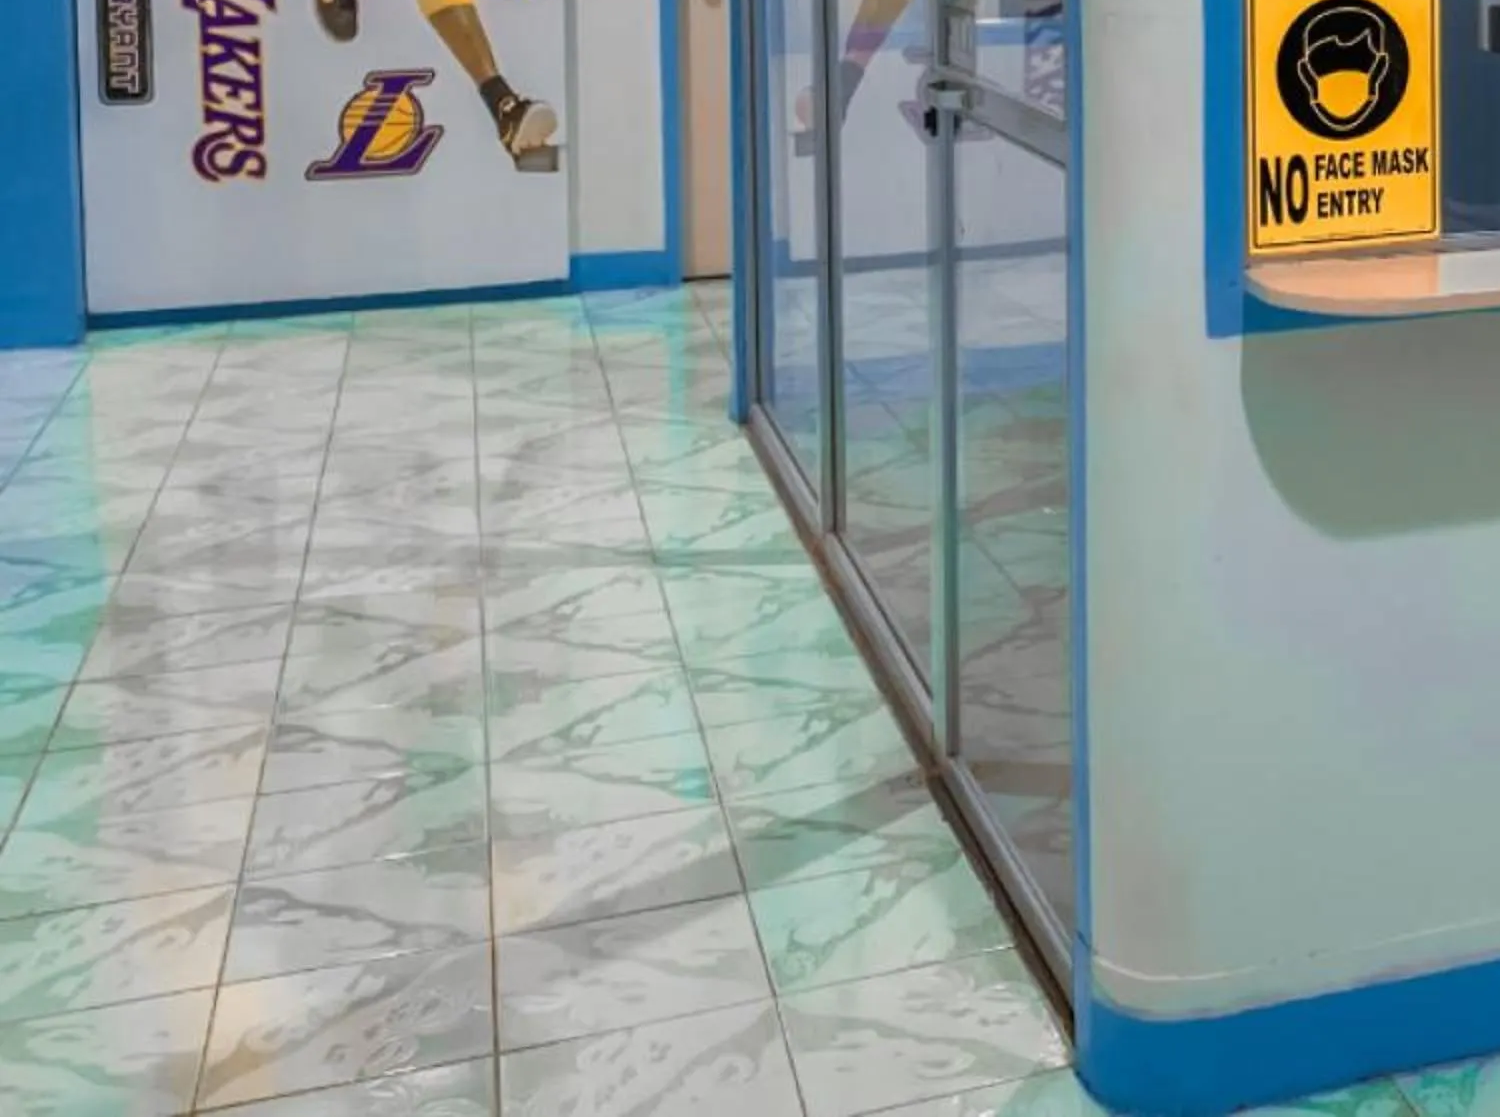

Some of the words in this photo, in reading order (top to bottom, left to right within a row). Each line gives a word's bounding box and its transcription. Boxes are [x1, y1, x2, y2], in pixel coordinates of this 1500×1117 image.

[1315, 150, 1366, 181] FACE
[1372, 147, 1429, 176] MASK
[1259, 154, 1309, 227] NO
[1317, 187, 1385, 219] ENTRY
